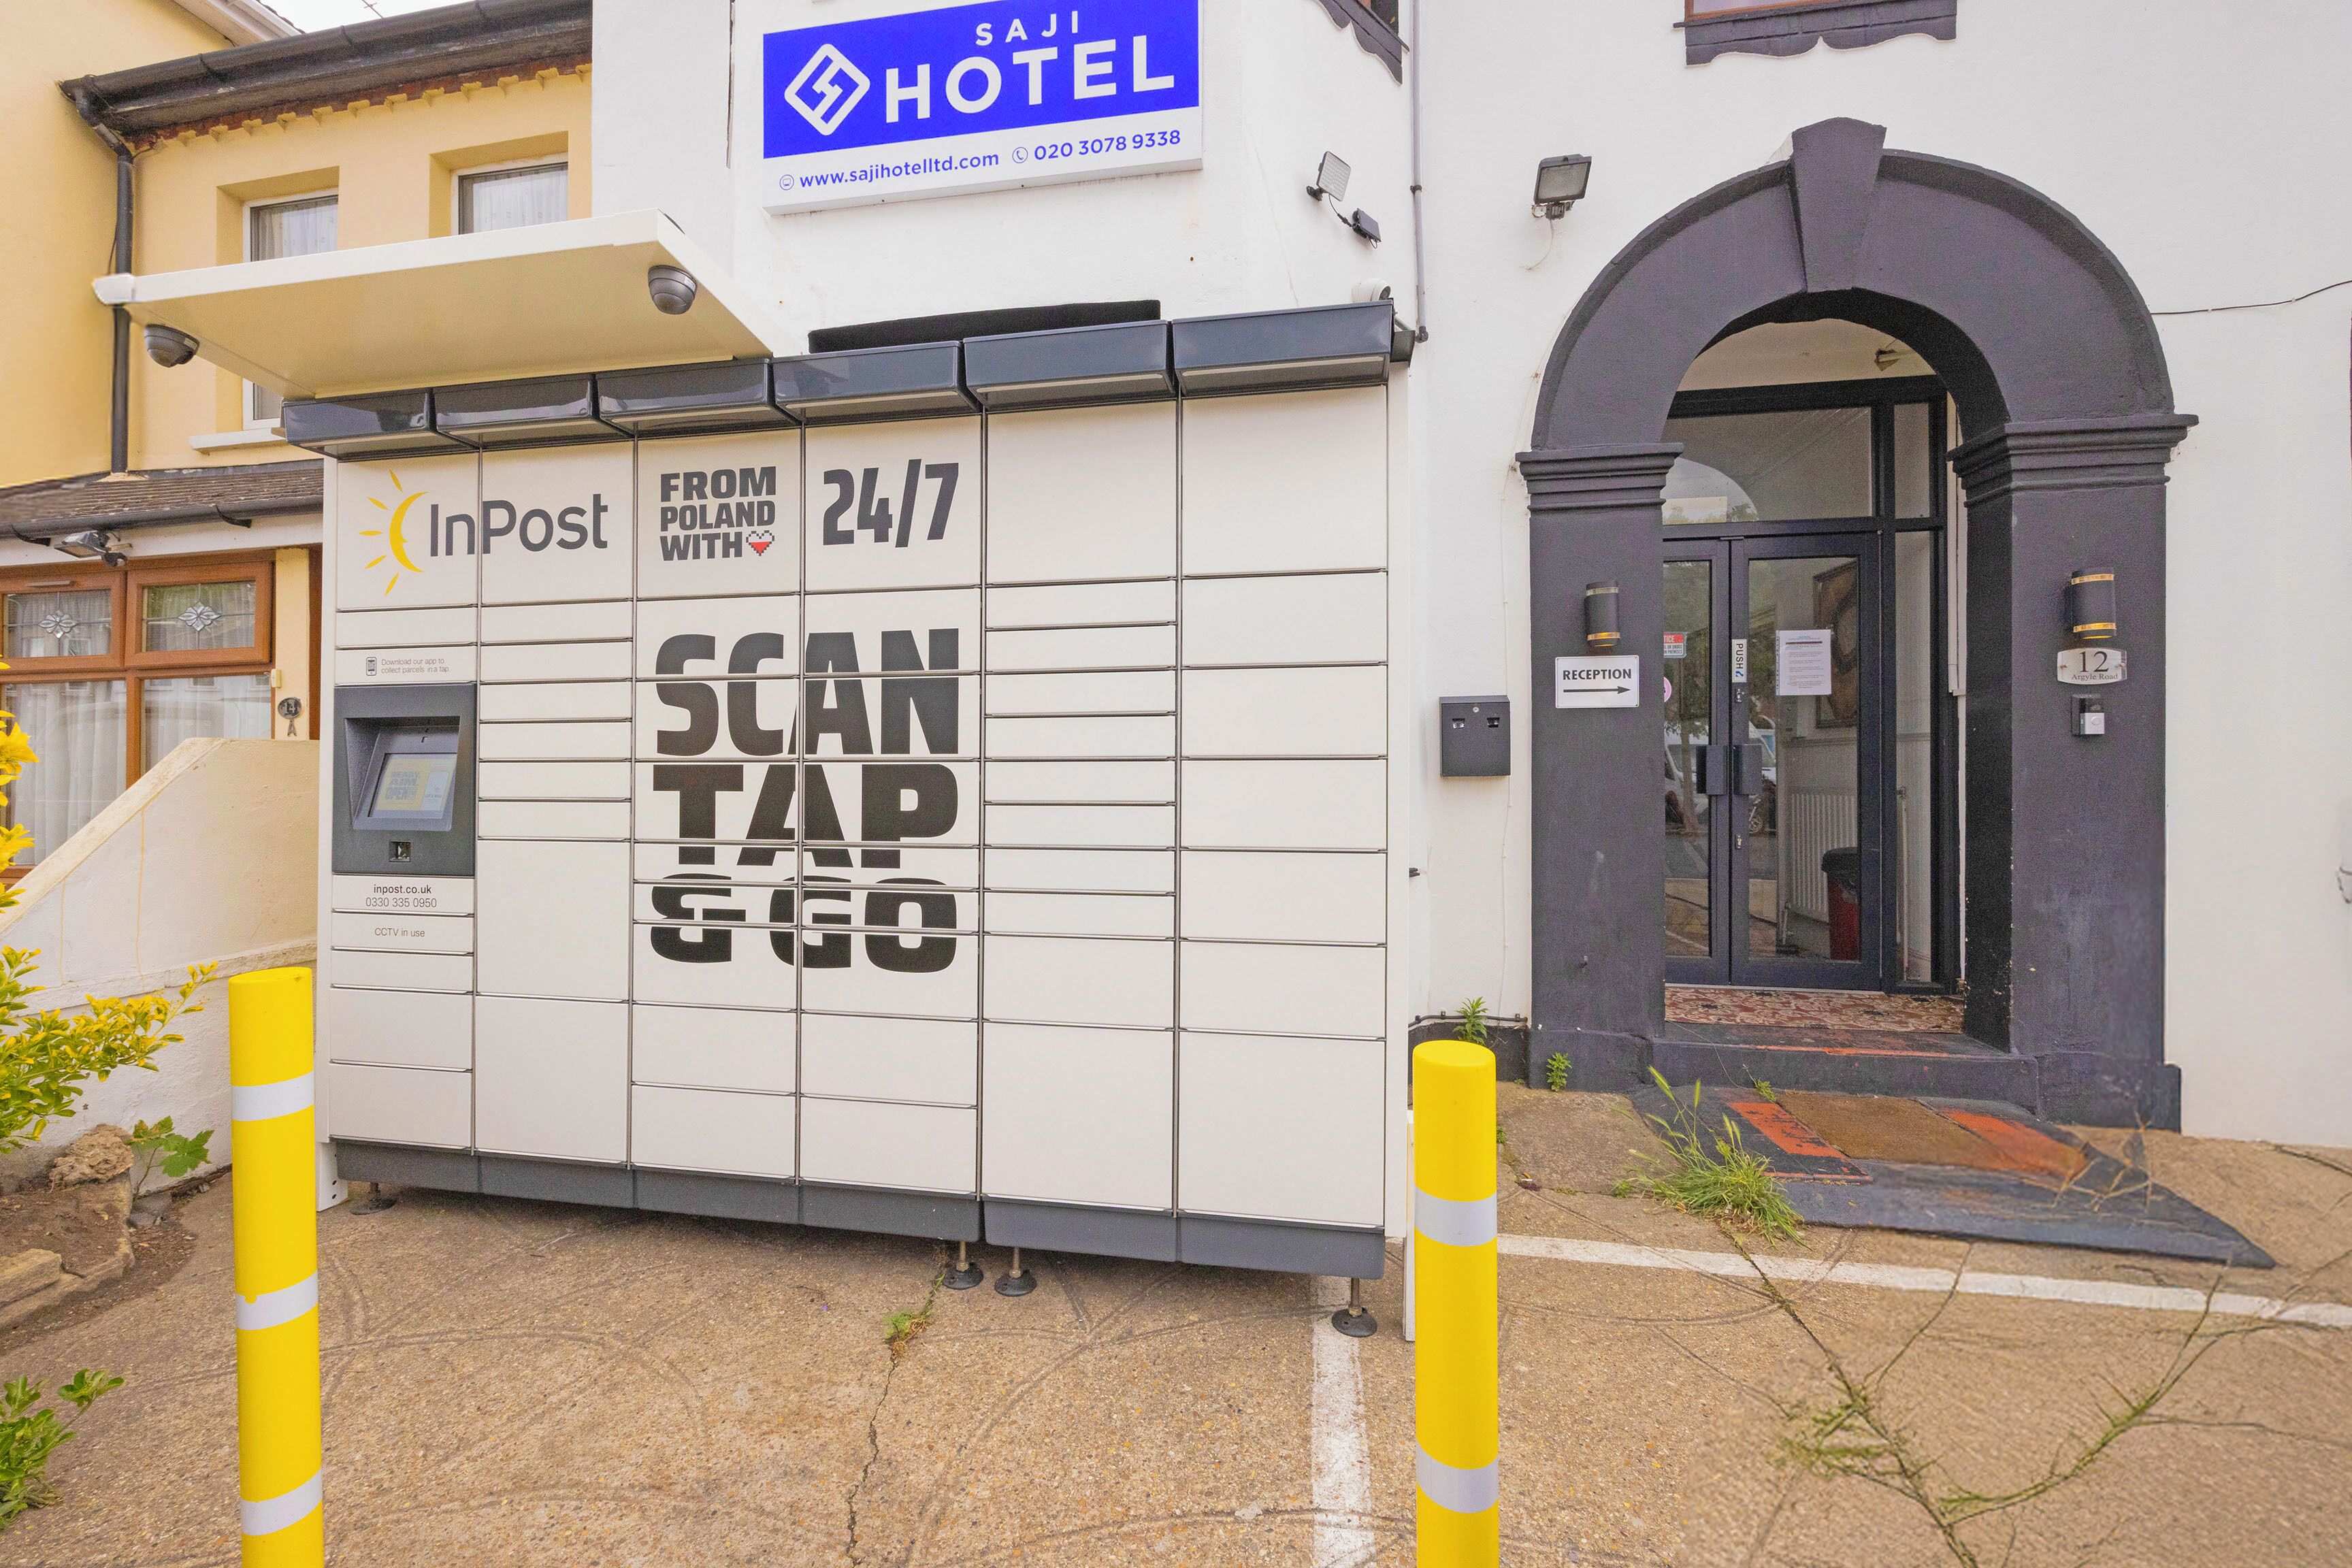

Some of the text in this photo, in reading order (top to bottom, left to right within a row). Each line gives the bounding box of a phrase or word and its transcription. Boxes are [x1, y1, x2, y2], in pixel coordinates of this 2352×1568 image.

[975, 10, 1079, 46] SAJI
[886, 35, 1174, 123] HOTEL
[799, 130, 1181, 189] www.sajihotelltd.com 020 3078 9338
[660, 466, 777, 502] FROM
[659, 500, 776, 530] POLAND
[823, 459, 960, 549] 24/7
[429, 493, 608, 557] InPost
[660, 532, 743, 561] WITH
[1735, 643, 1744, 669] PUSH
[2079, 651, 2109, 672] 12
[1563, 668, 1632, 681] RECEPTION
[655, 628, 959, 757] SCAN
[653, 764, 959, 869] TAP
[365, 897, 437, 908] 0330 335 0950
[374, 884, 431, 895] inpost.co.uk
[374, 928, 399, 936] CCTV
[401, 928, 408, 936] in
